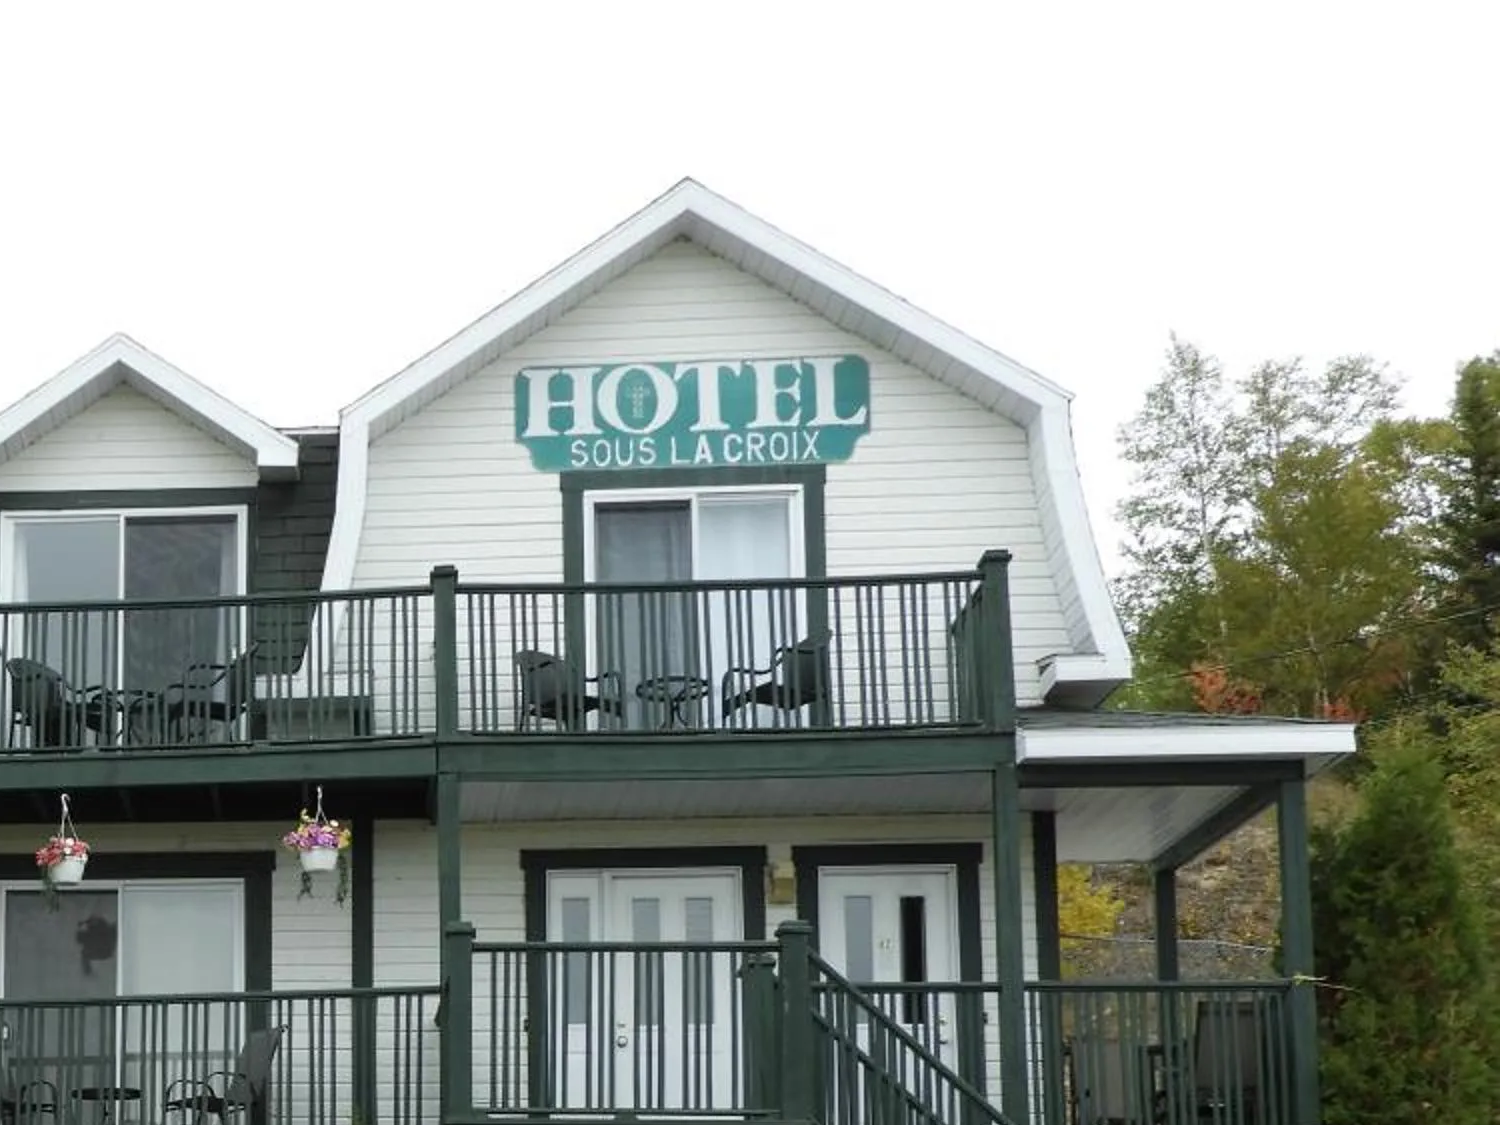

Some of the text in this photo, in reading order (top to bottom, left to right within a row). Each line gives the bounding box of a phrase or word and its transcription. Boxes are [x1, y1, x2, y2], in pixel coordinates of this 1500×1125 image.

[521, 357, 867, 437] HOTEL
[570, 431, 821, 467] SOUS LA CROIX
